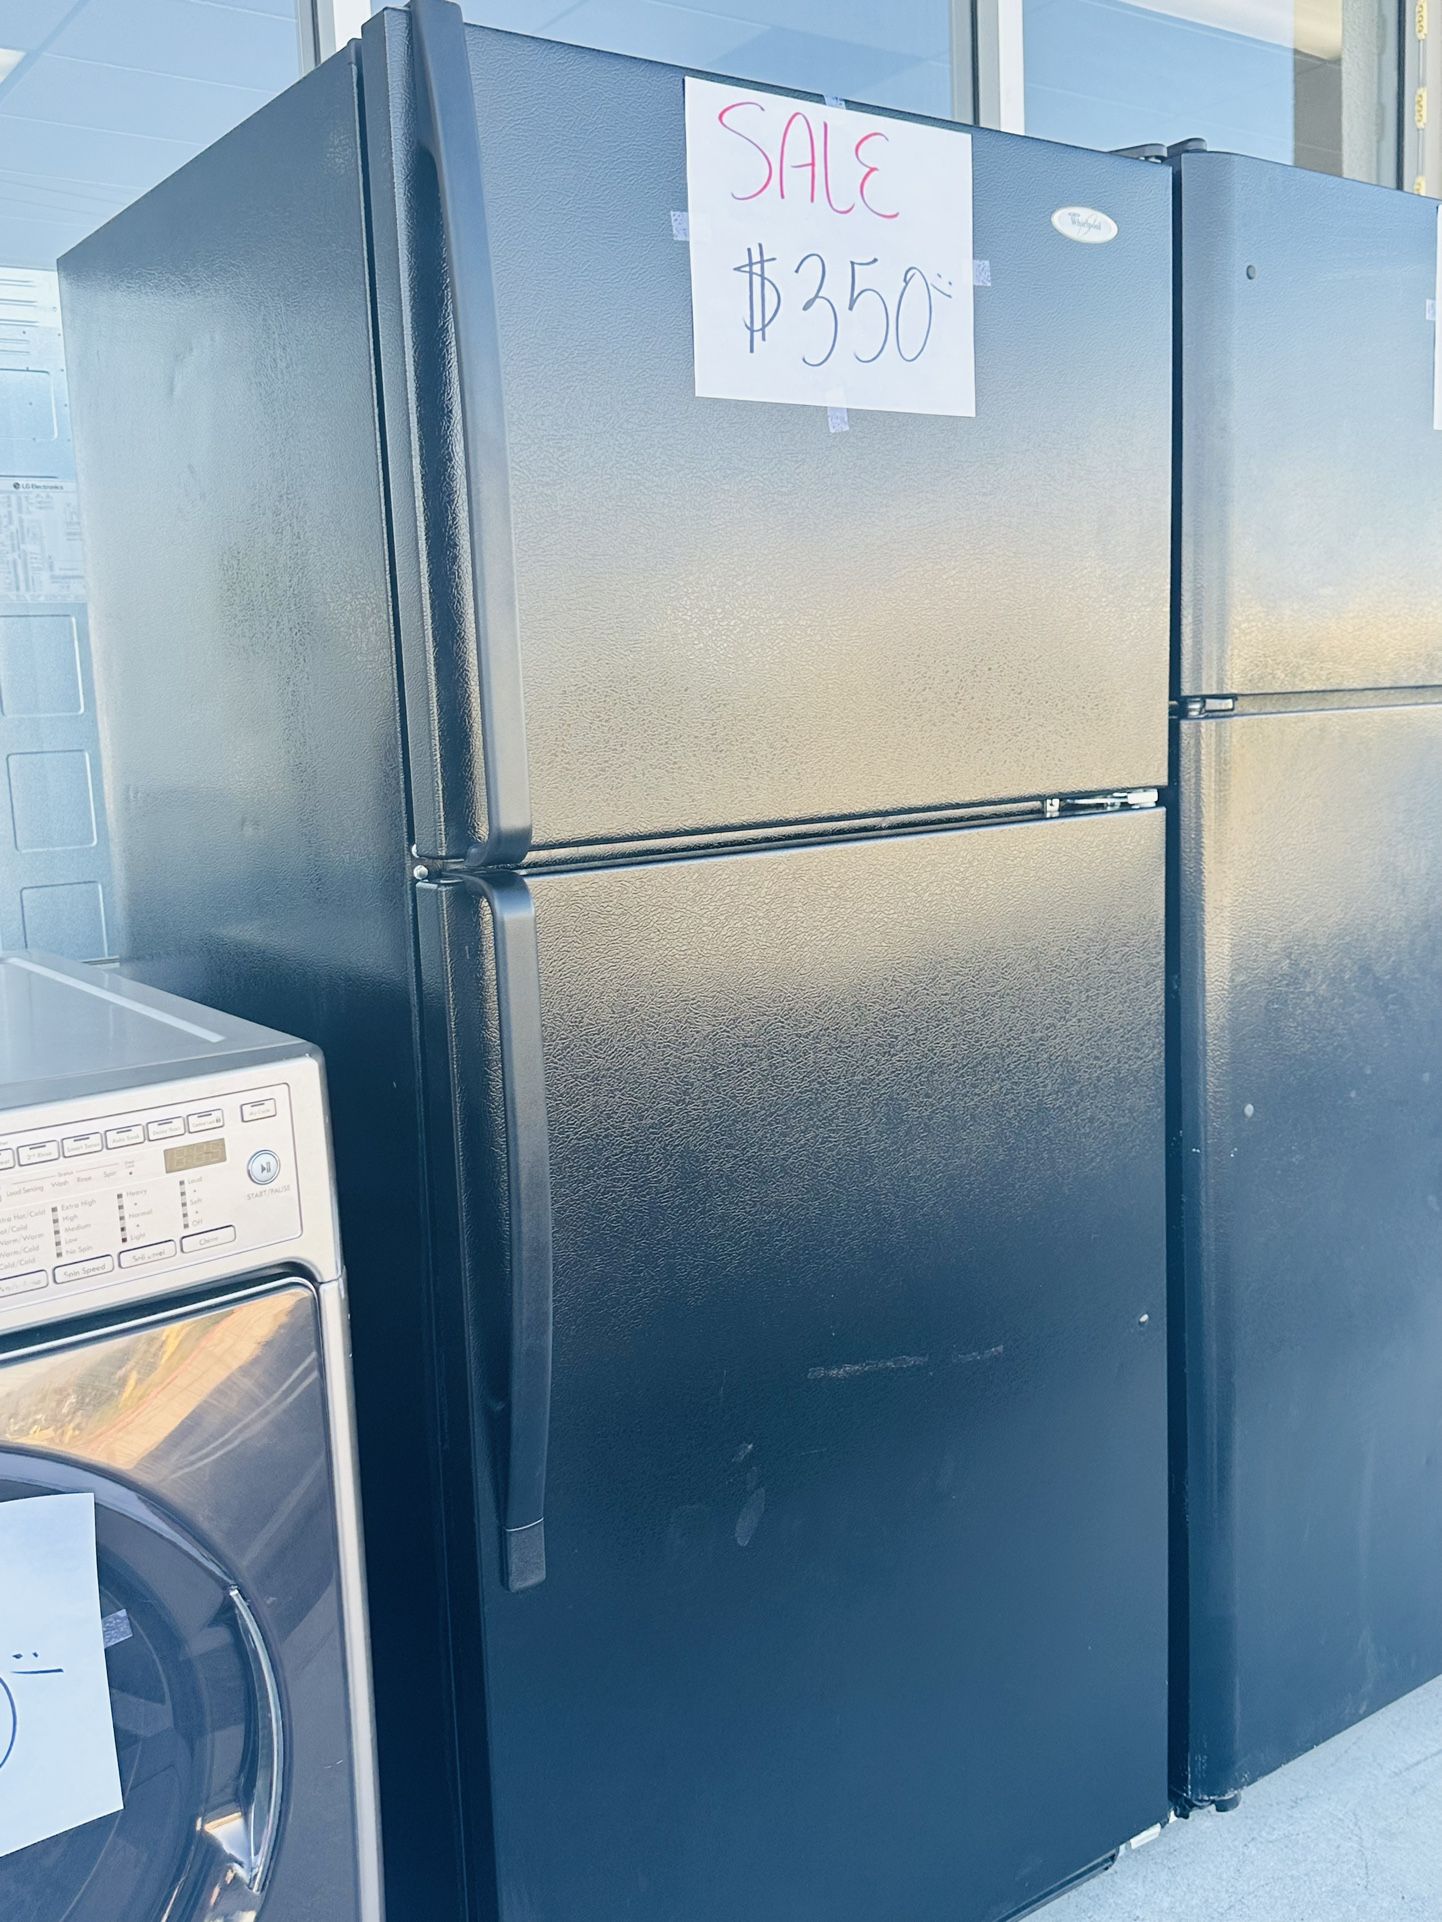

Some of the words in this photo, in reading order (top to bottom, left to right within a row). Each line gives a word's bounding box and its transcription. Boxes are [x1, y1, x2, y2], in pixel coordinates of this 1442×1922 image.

[718, 101, 900, 219] SALE
[126, 1189, 147, 1197] Heavy
[247, 1184, 291, 1200] START/PAUSE
[61, 1202, 79, 1211] Extra
[81, 1199, 97, 1208] High
[63, 1214, 78, 1222] High
[129, 1208, 153, 1218] Normal
[0, 1224, 28, 1235] ot/Cold
[65, 1223, 91, 1233] Medium
[65, 1237, 78, 1245] Low
[63, 1269, 81, 1279] Spin
[82, 1264, 106, 1276] Speed
